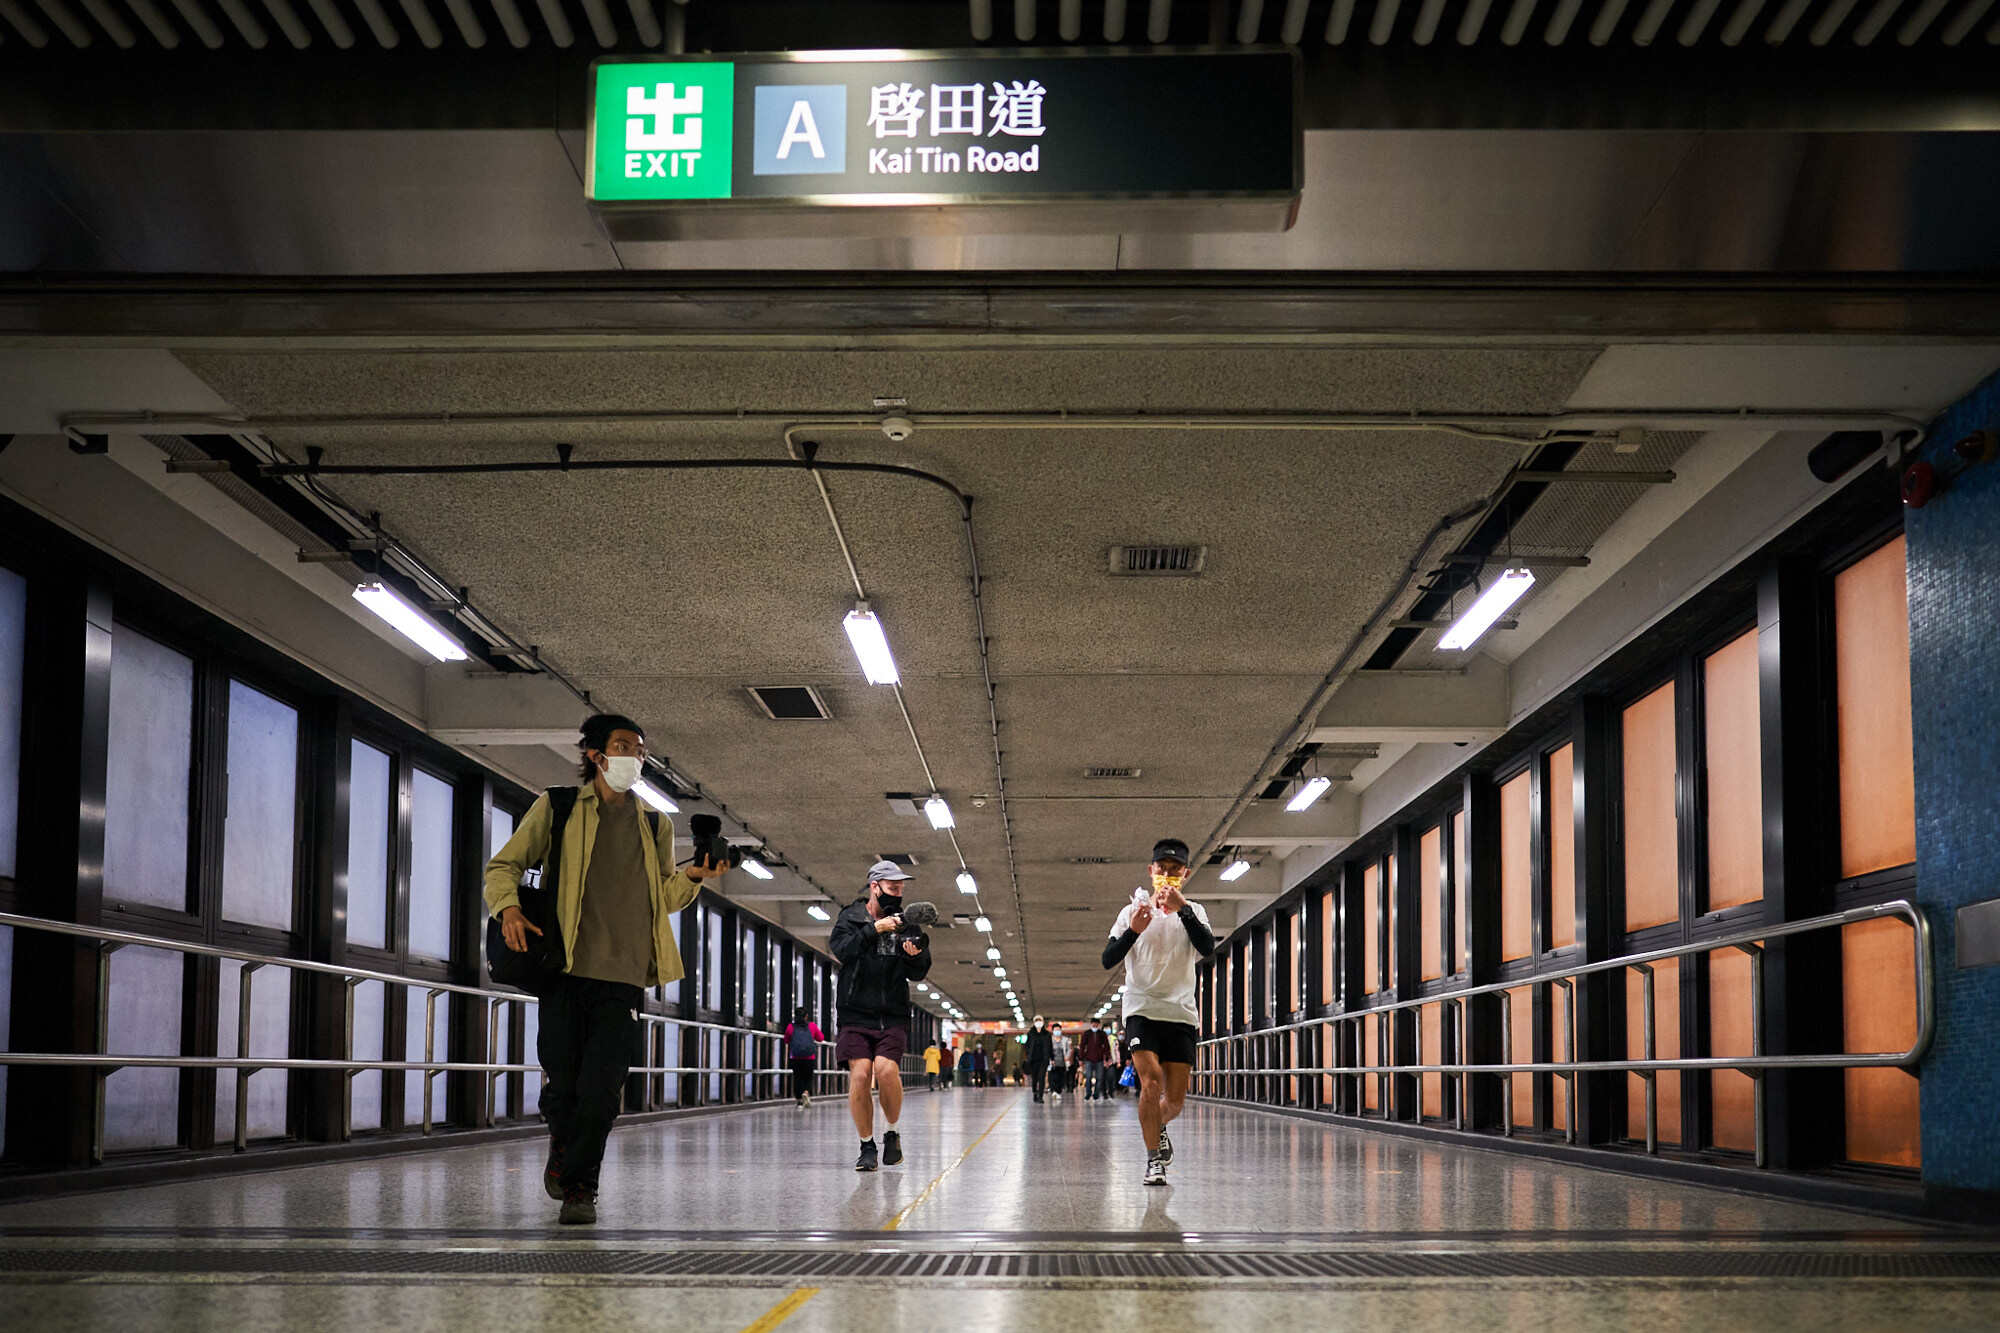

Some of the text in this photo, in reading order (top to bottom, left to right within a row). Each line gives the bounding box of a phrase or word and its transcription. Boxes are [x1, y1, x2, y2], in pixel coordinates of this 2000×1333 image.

[625, 83, 703, 151] 出
[775, 100, 826, 160] A
[866, 80, 1047, 139] 啓田道
[624, 152, 702, 178] EXIT
[868, 144, 1039, 174] Kai Tin Road
